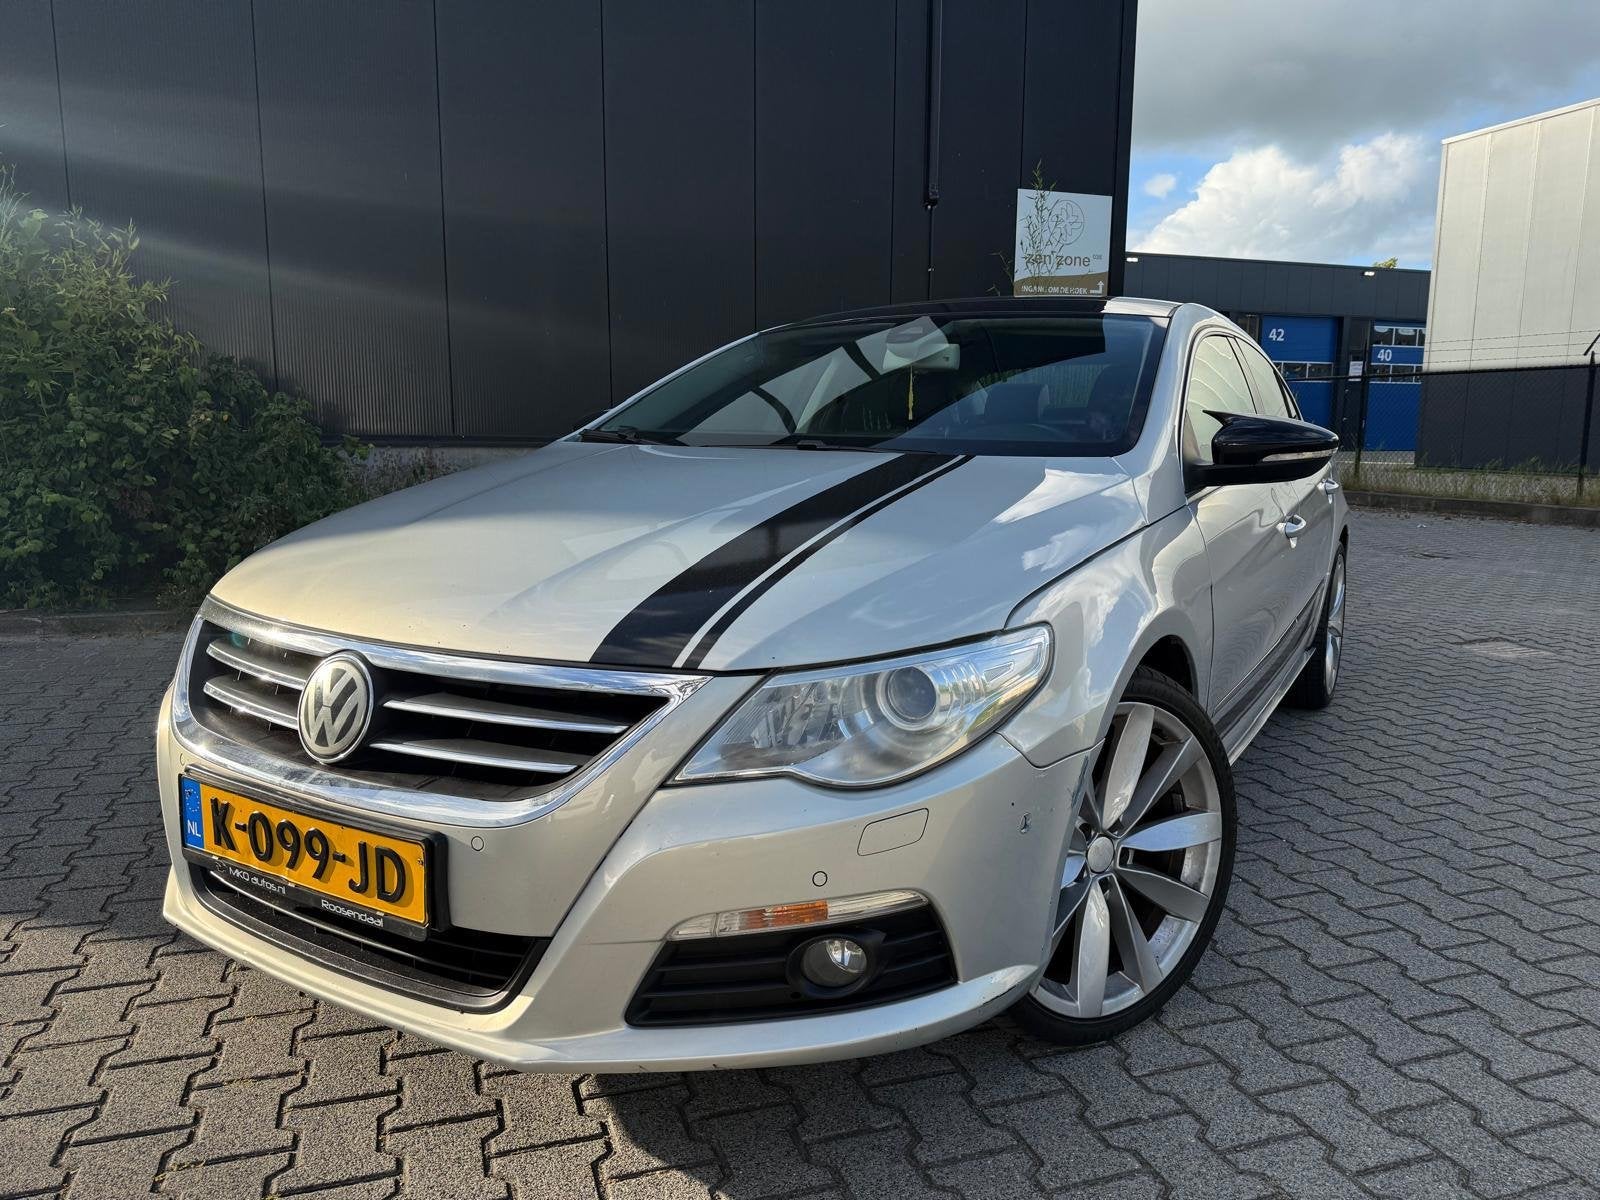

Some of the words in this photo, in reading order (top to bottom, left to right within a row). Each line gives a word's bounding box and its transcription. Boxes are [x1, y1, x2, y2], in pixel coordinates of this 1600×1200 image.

[1056, 255, 1090, 267] zone
[1268, 328, 1285, 342] 42
[1377, 348, 1393, 362] 40
[187, 819, 201, 838] NL
[210, 796, 406, 904] K-099-JD
[250, 876, 286, 895] autos.nl
[321, 899, 384, 928] Roosendaal
